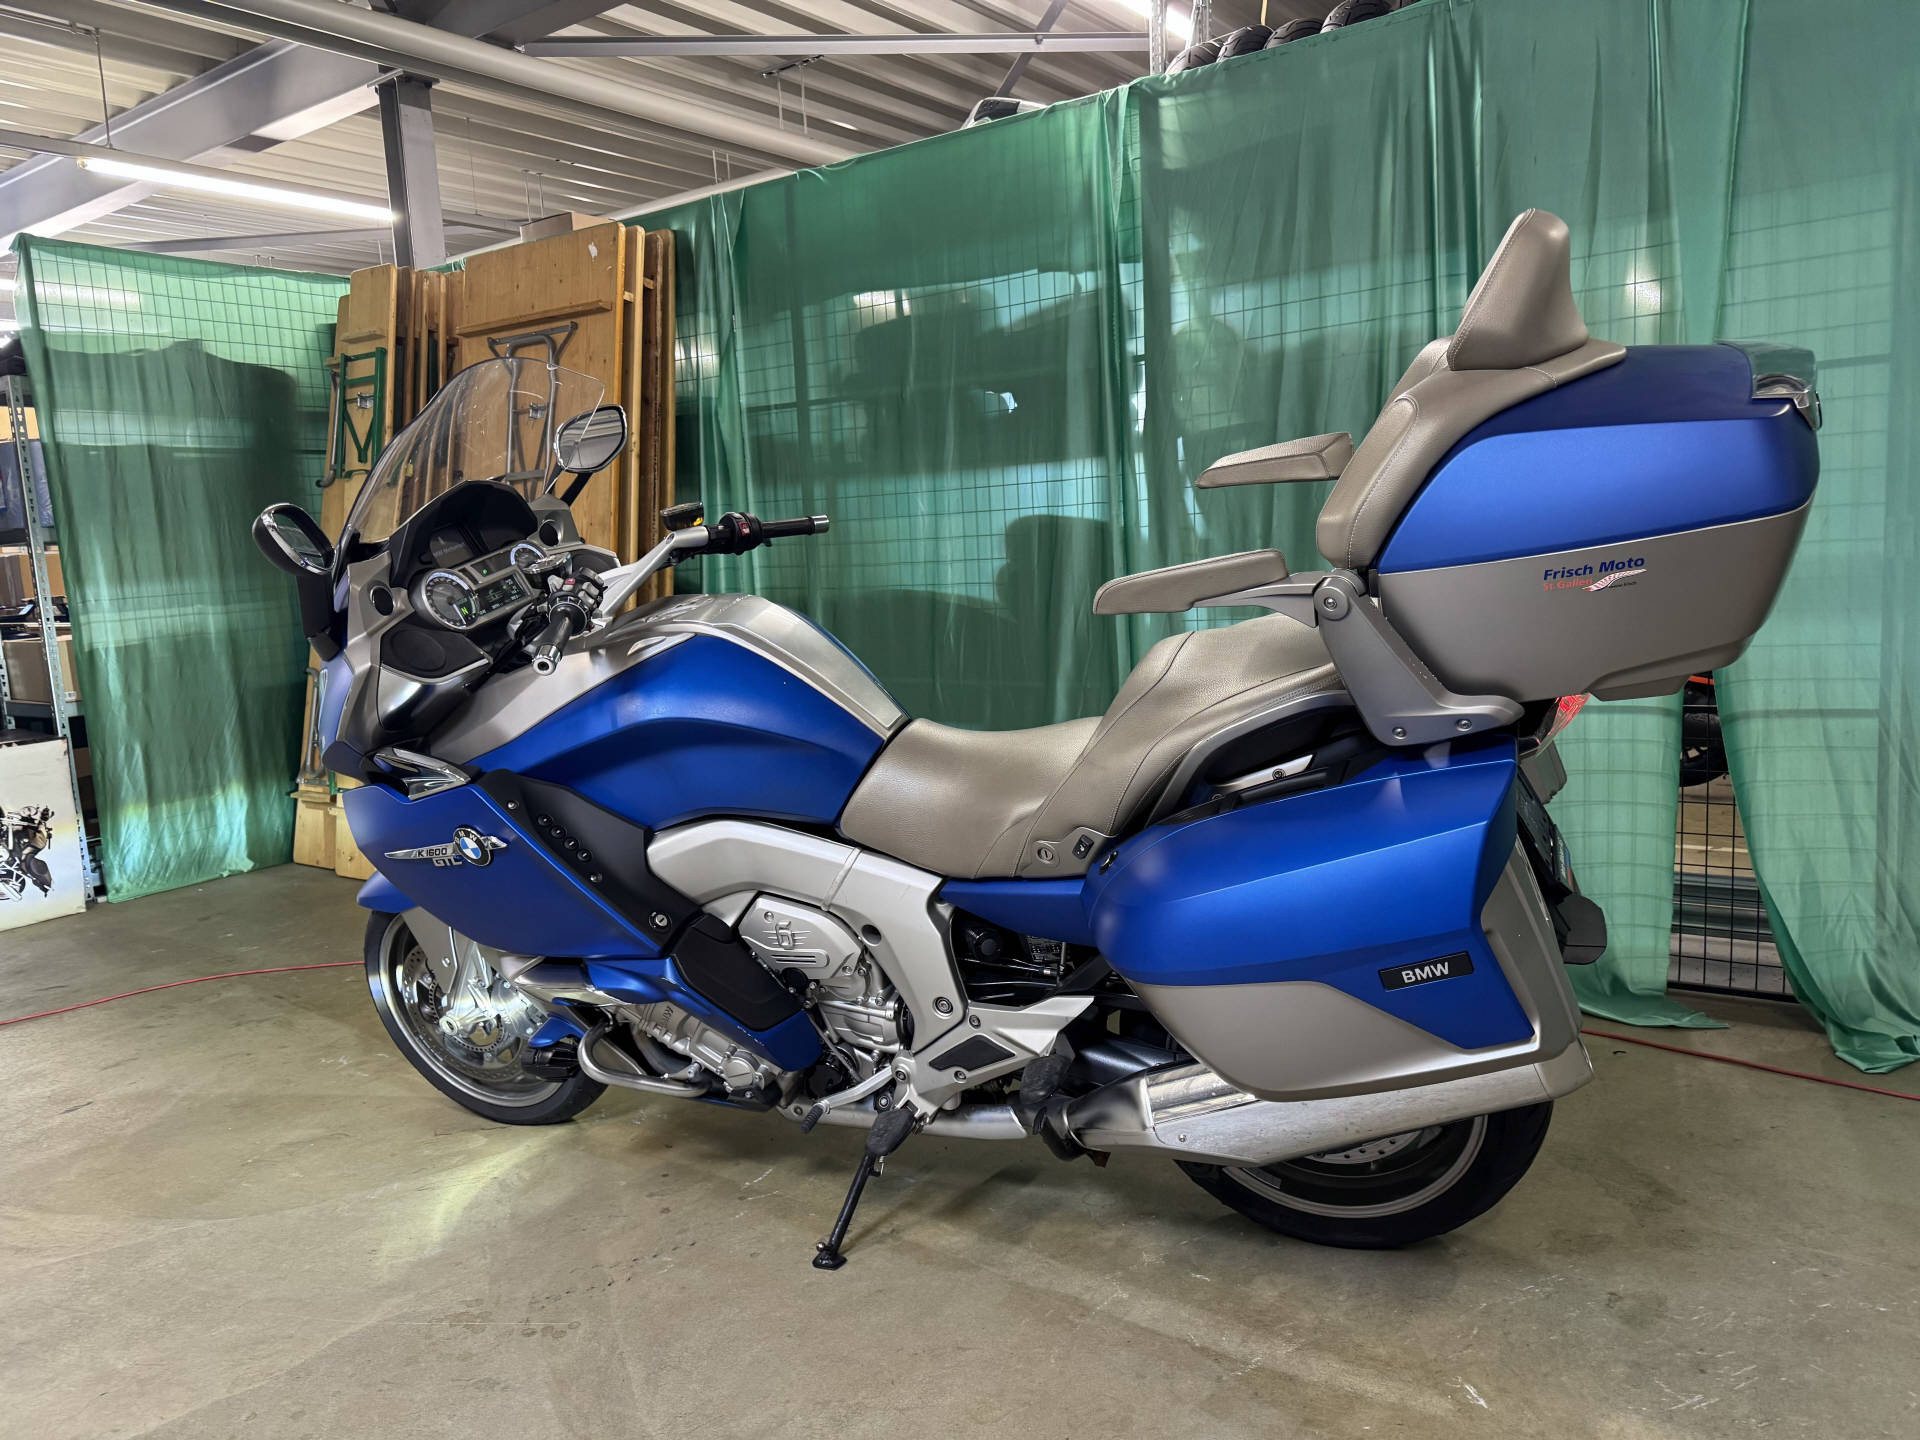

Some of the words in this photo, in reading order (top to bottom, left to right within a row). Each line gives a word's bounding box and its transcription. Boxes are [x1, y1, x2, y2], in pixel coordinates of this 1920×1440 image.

[1543, 564, 1593, 580] Frisch
[1599, 557, 1645, 572] Moto
[1557, 578, 1593, 590] Gallen
[417, 849, 424, 857] K
[426, 847, 448, 857] 1600
[1401, 962, 1449, 983] BMW
